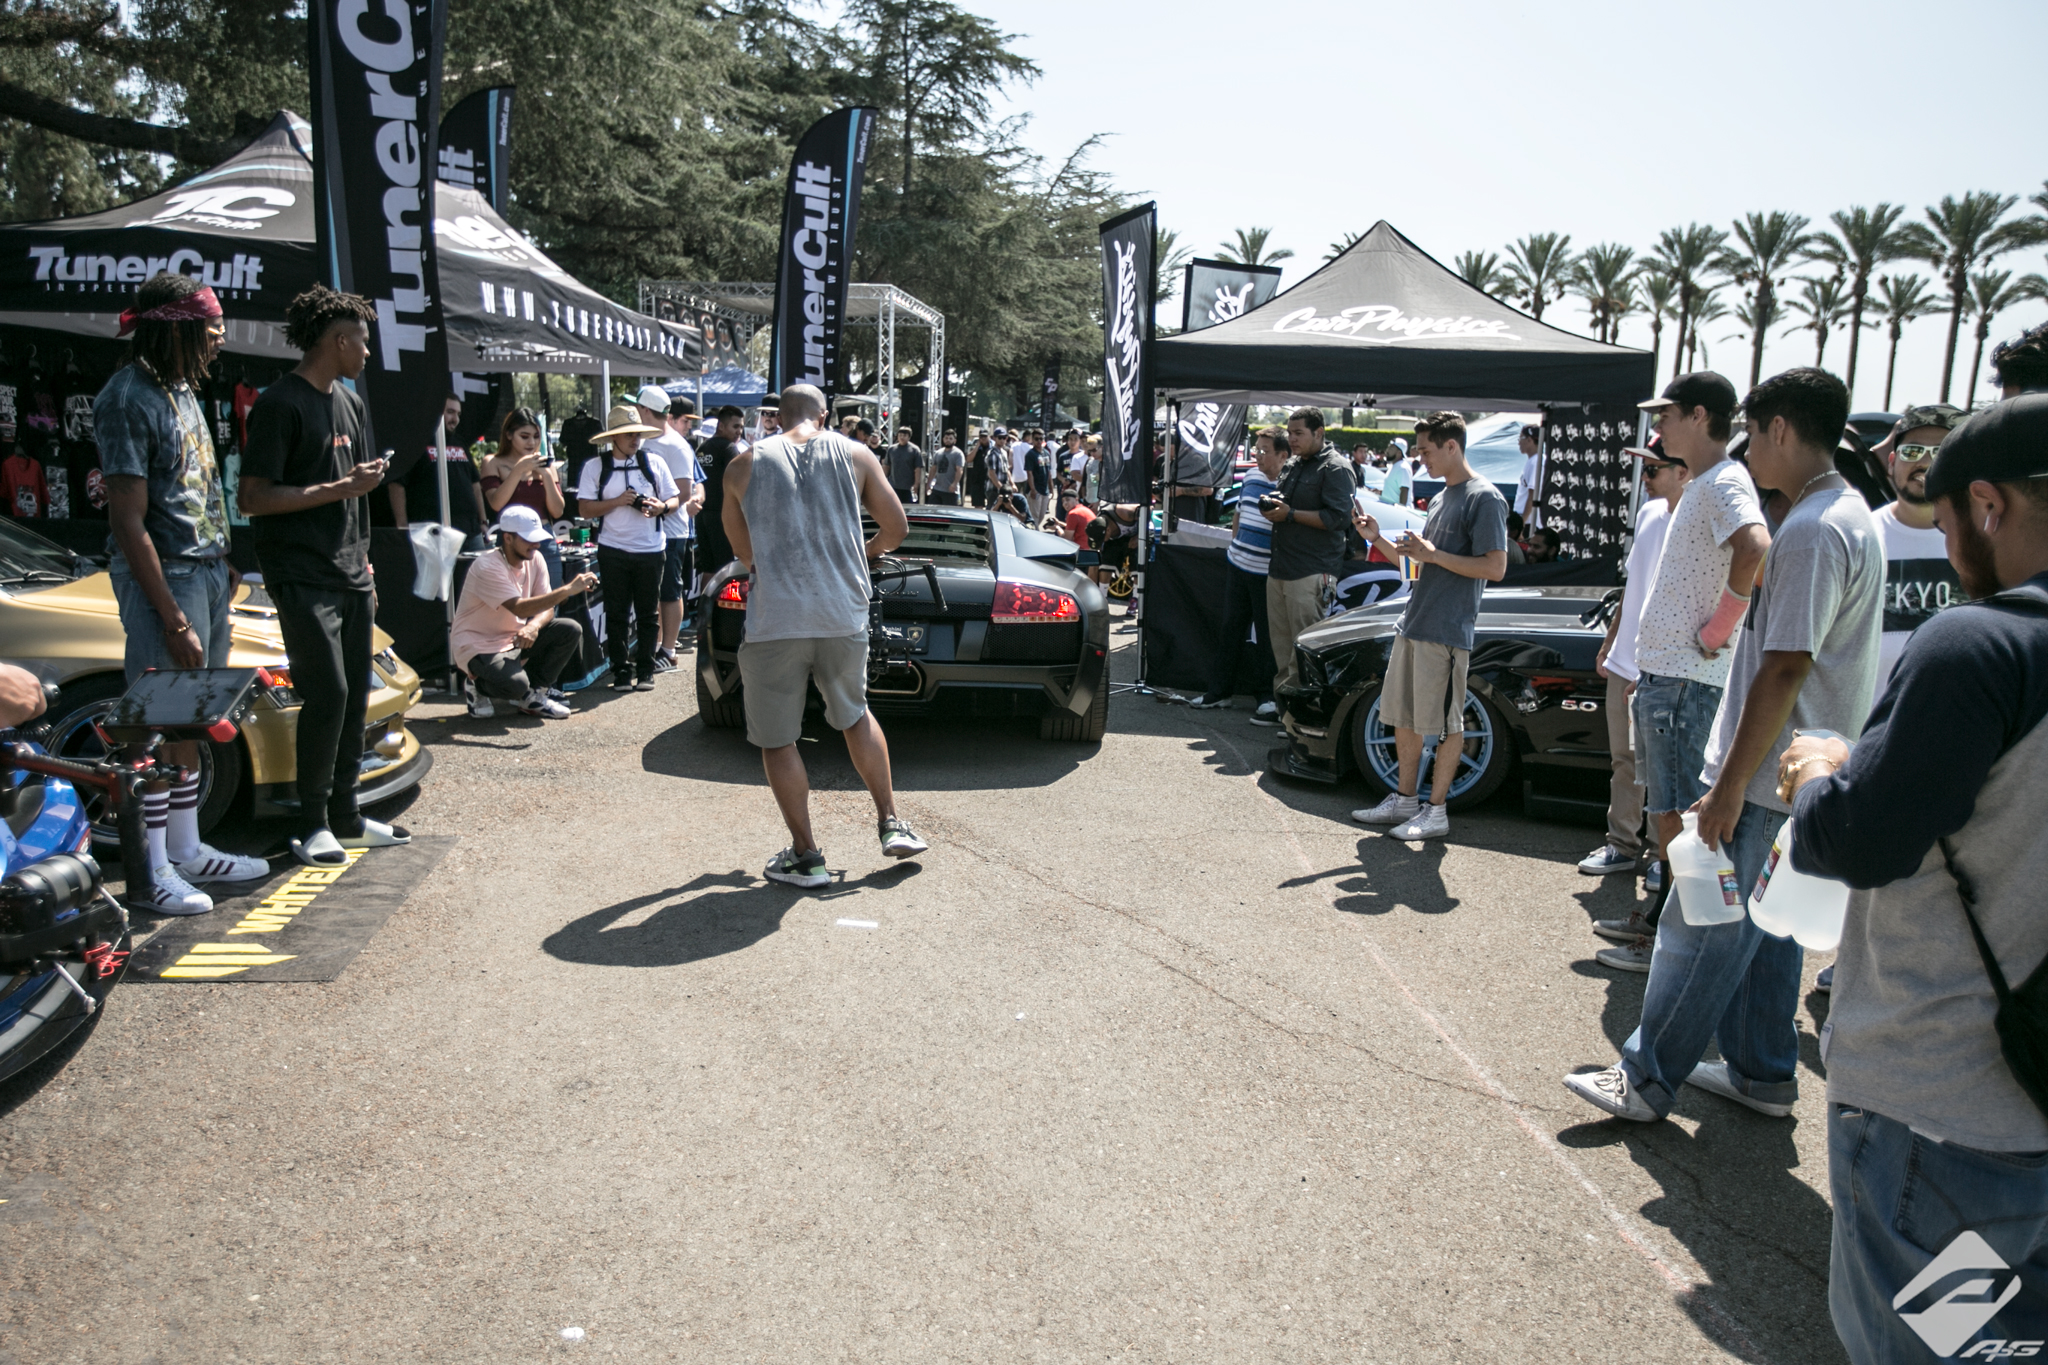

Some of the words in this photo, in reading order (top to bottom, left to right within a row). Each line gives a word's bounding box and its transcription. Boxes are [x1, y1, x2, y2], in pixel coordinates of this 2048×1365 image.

[830, 176, 842, 244] TRUST
[29, 246, 263, 291] TunerCult
[793, 161, 832, 388] unerCult
[828, 260, 837, 284] WE
[826, 299, 836, 364] SPEED
[1273, 305, 1521, 343] CarPhysics
